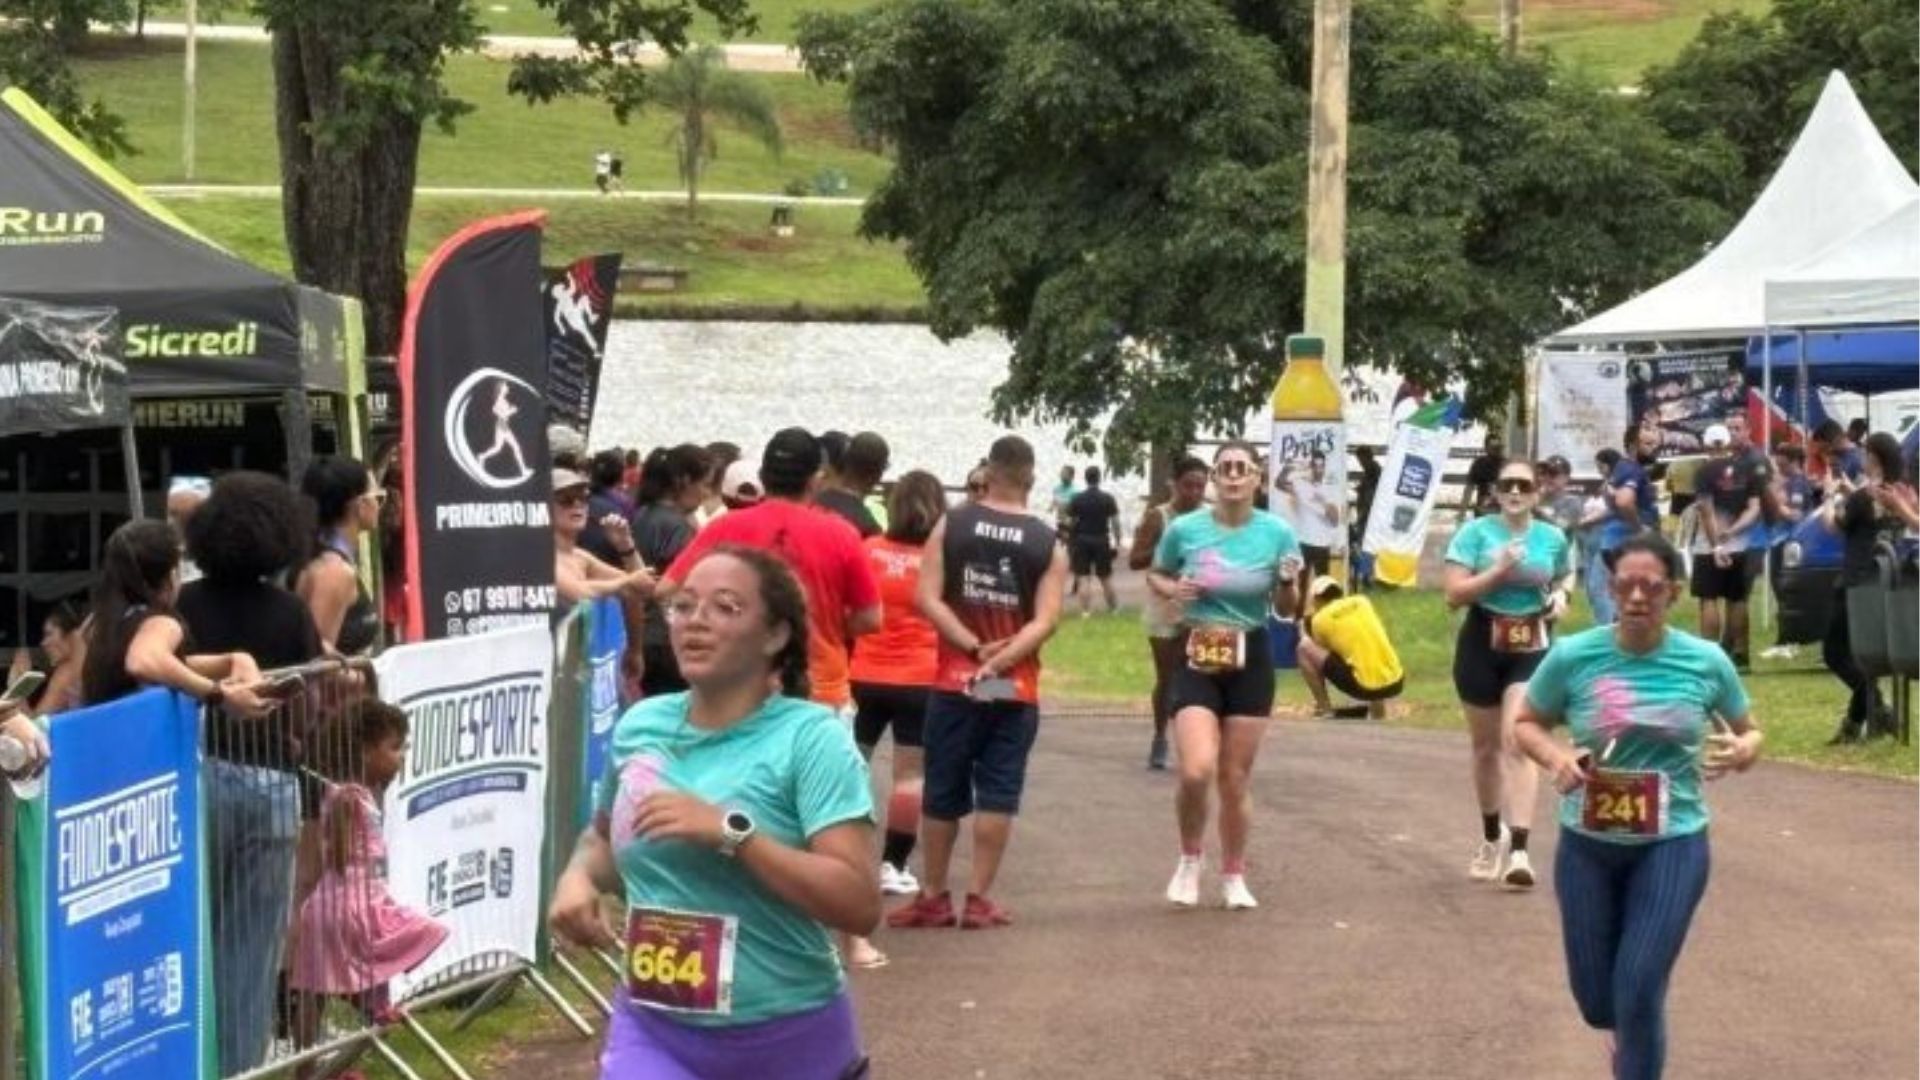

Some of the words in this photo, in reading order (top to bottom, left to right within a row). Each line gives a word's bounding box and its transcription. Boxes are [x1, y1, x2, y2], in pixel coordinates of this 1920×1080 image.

[0, 207, 104, 233] Run
[124, 322, 258, 357] Sicredi
[435, 502, 526, 530] PRIMEIRO
[974, 521, 1023, 544] ATLETA
[1195, 644, 1233, 665] 342
[1596, 793, 1647, 822] 241
[58, 784, 181, 892] FUNDESPORTE
[631, 942, 707, 988] 664
